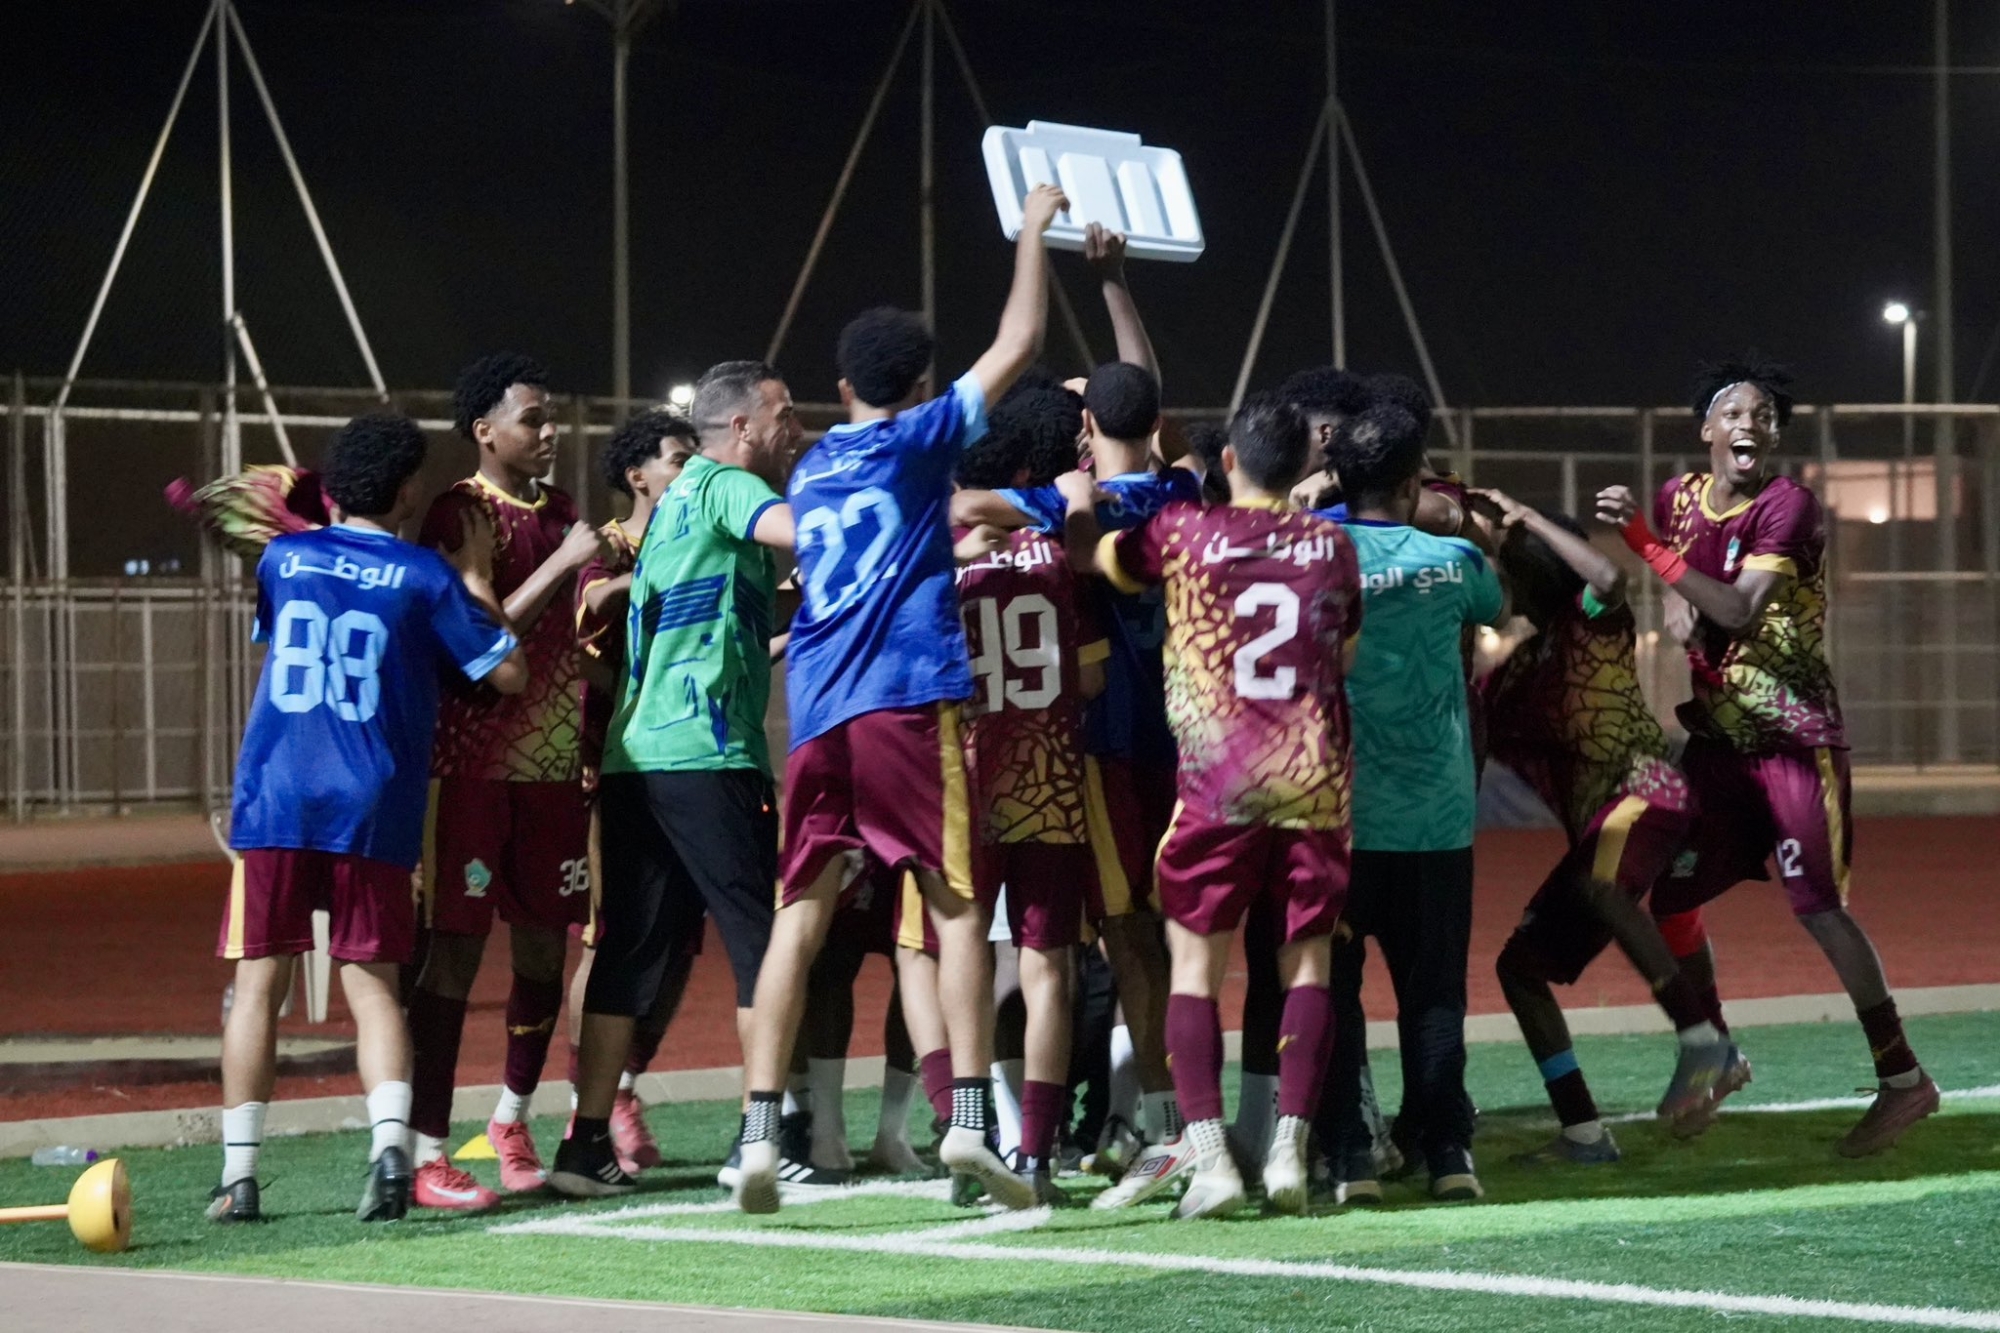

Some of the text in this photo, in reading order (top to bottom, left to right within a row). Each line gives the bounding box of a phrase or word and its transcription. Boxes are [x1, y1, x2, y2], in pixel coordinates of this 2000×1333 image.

[279, 552, 406, 590] الوطن
[797, 486, 903, 622] 22
[1203, 531, 1334, 566] الوطن
[1360, 561, 1463, 595] نادي الو
[270, 600, 390, 722] 88
[1233, 582, 1300, 700] 2
